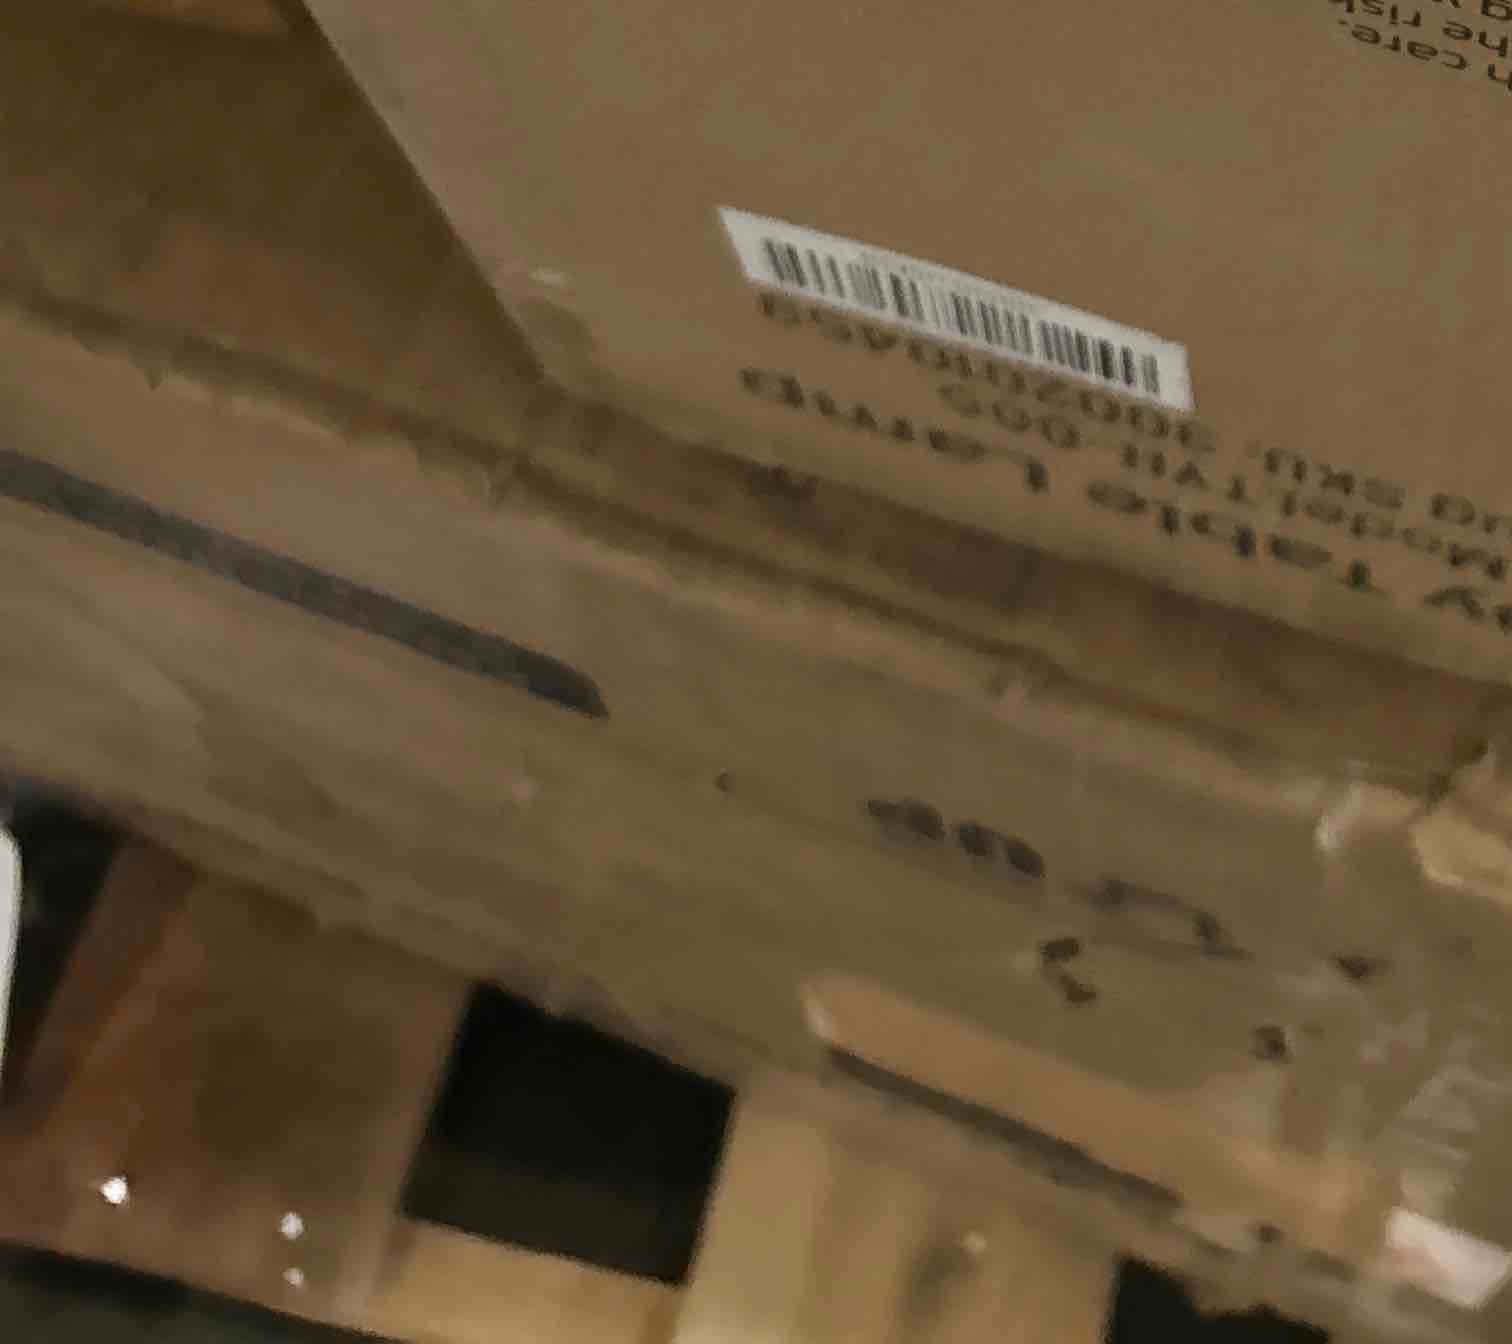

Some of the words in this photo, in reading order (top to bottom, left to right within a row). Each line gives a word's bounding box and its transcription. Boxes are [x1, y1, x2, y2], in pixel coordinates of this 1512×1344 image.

[1337, 18, 1470, 72] care.
[738, 368, 1050, 496] Lamp
[1086, 482, 1385, 596] Table
